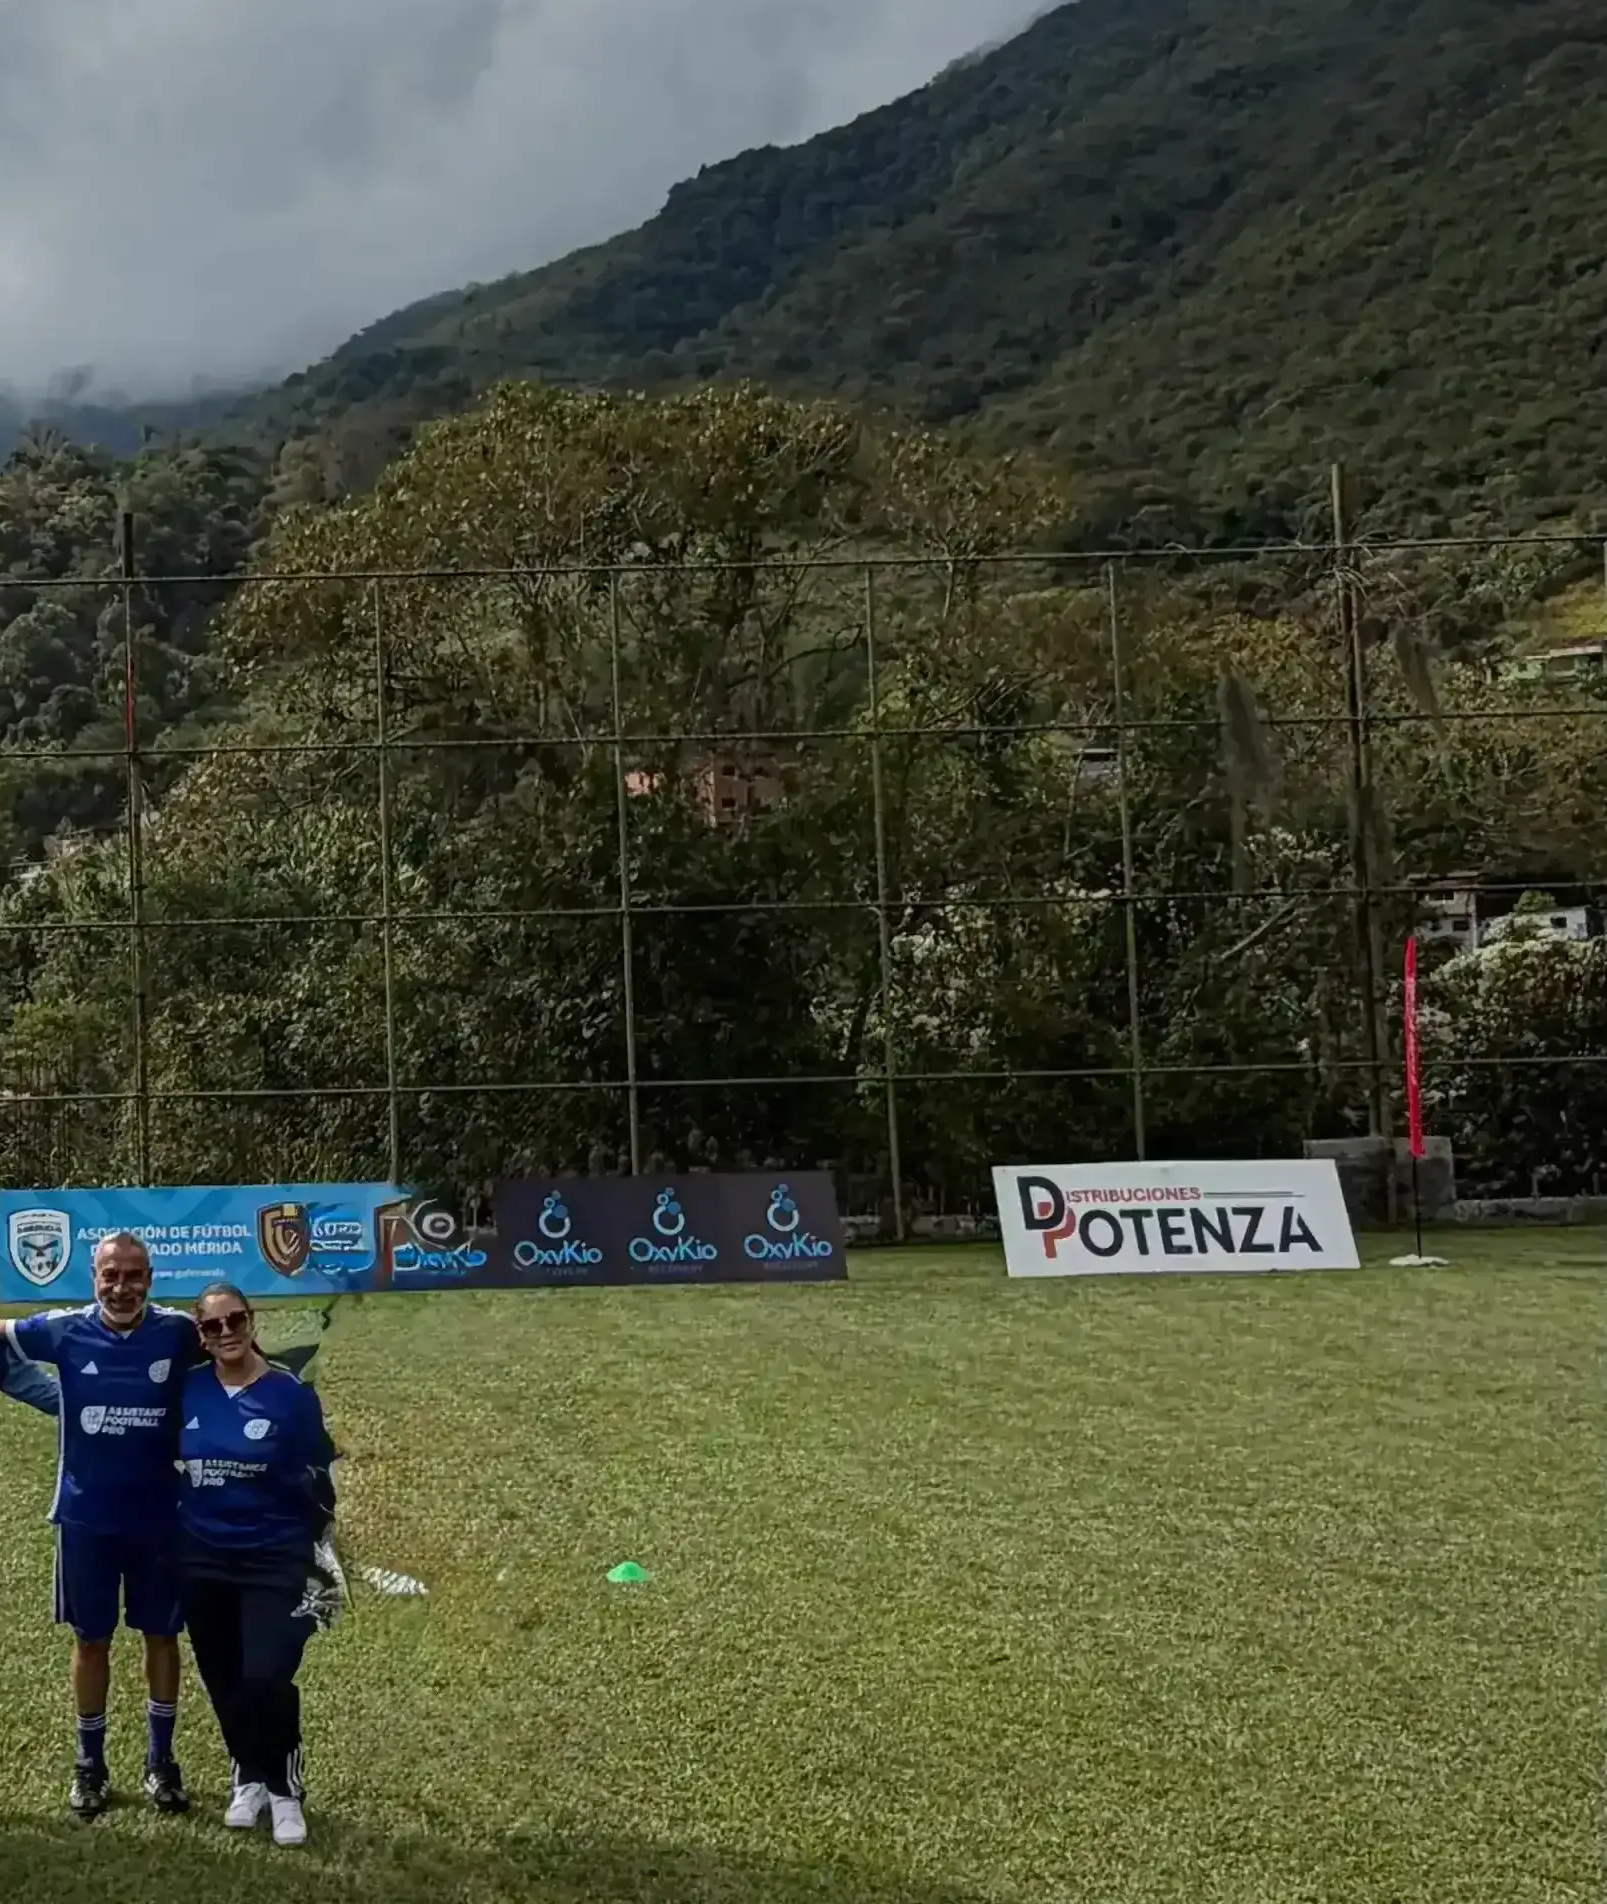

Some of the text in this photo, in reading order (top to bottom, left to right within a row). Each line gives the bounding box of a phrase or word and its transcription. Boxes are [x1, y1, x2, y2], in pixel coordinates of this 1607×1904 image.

[169, 1226, 191, 1239] DE
[192, 1222, 252, 1239] FÚTBOL
[185, 1239, 243, 1255] MÉRIDA
